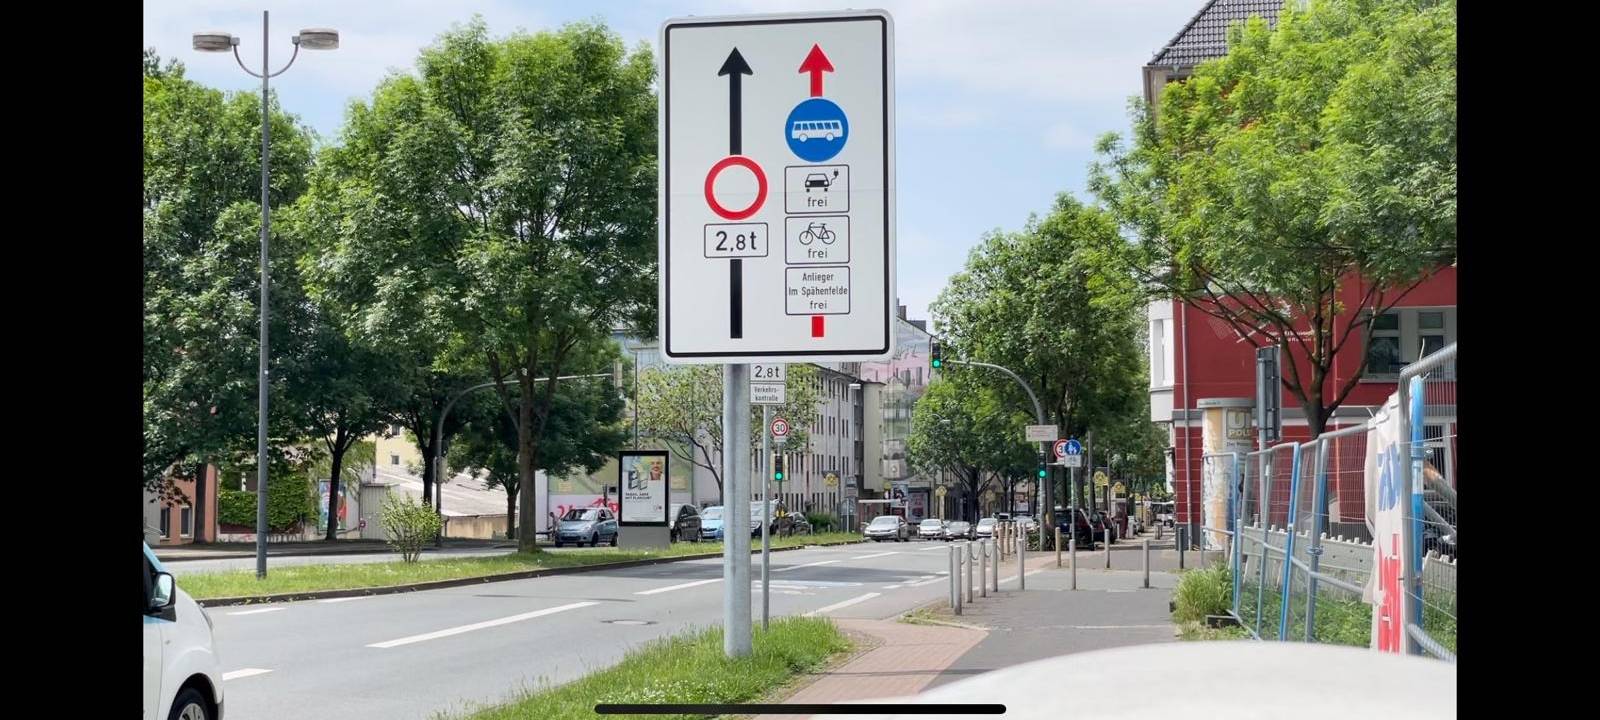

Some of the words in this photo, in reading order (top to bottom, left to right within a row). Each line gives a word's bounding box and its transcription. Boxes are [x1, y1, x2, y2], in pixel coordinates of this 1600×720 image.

[808, 197, 828, 207] frei
[808, 248, 828, 258] frei
[802, 272, 834, 283] Anlieger
[788, 287, 798, 296] Im
[801, 285, 848, 298] Spähenfelde
[810, 300, 827, 310] frei
[775, 423, 786, 432] 30
